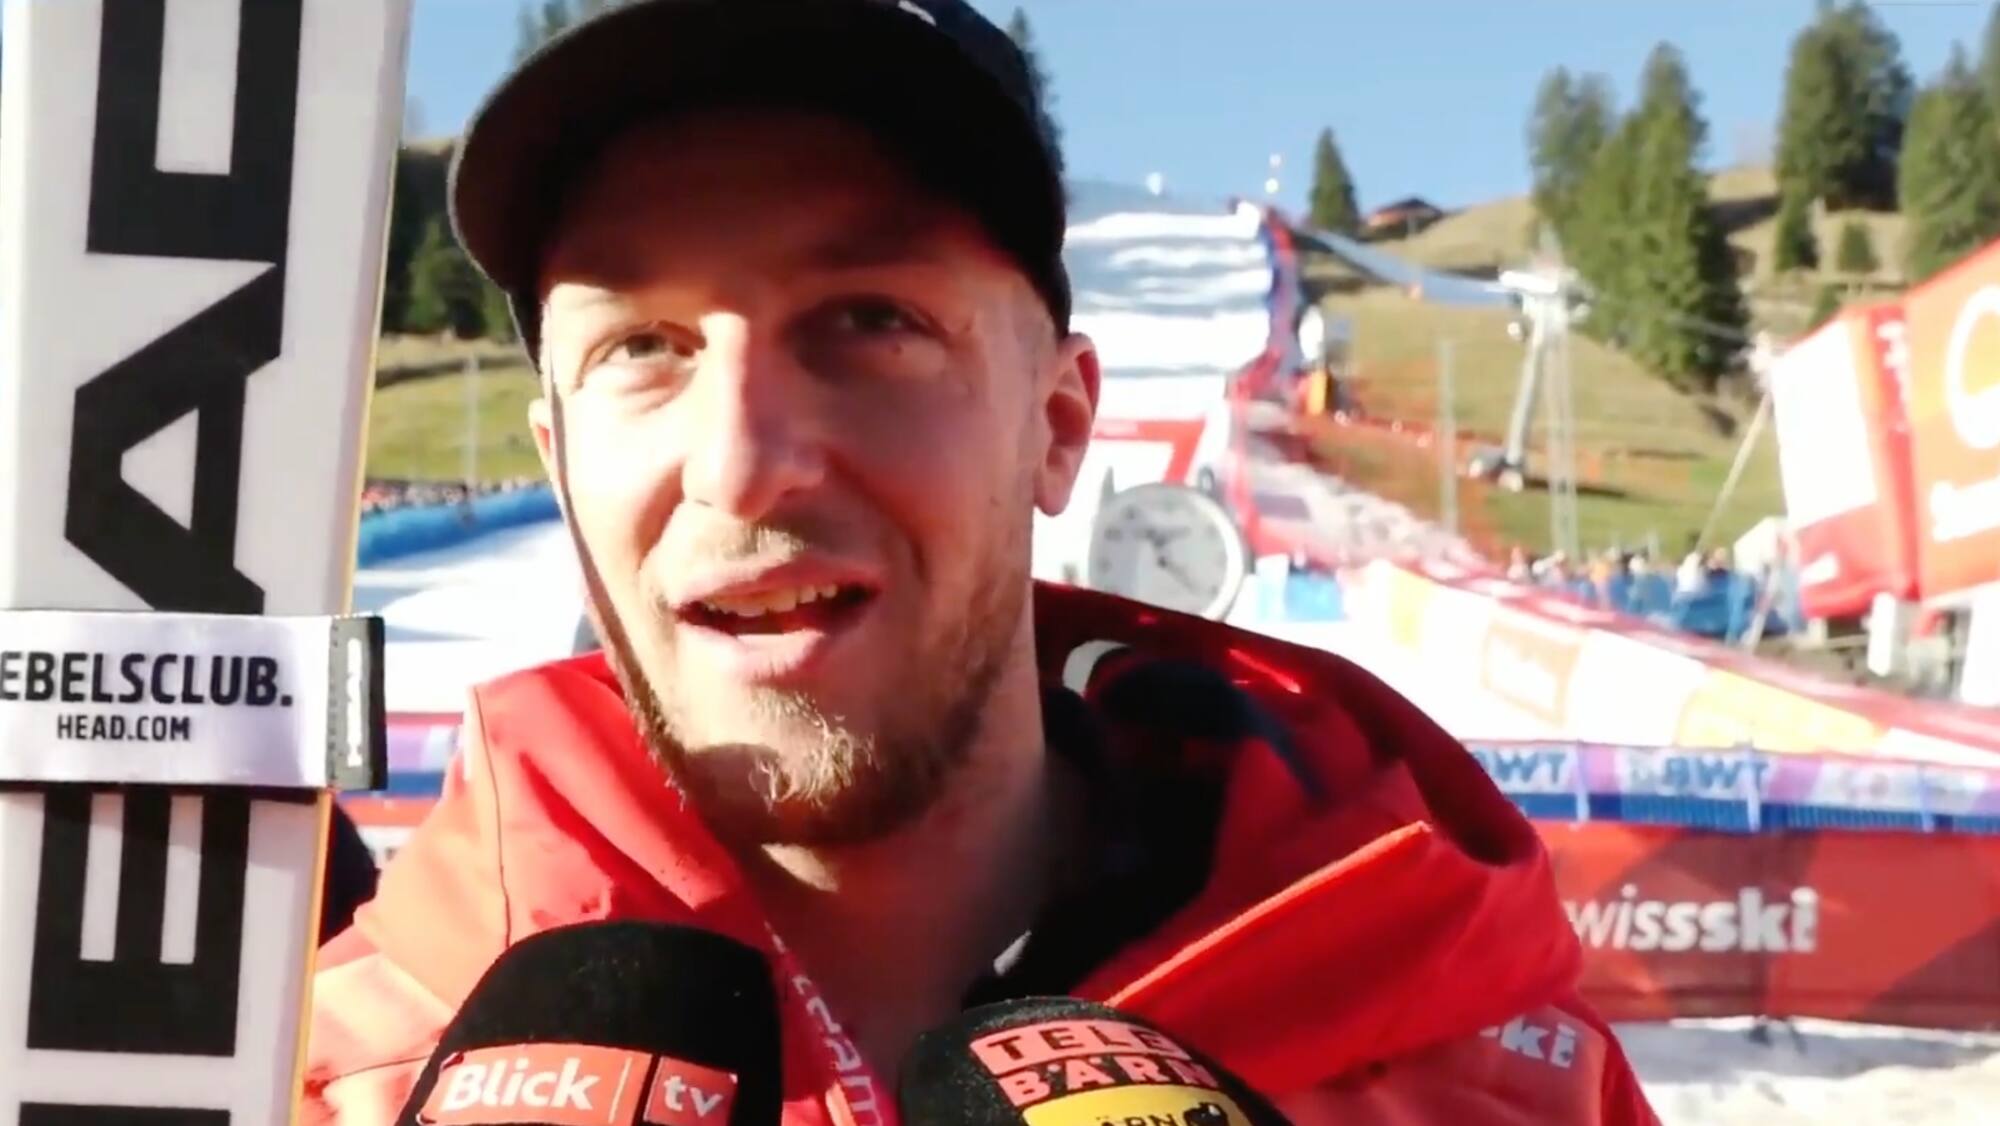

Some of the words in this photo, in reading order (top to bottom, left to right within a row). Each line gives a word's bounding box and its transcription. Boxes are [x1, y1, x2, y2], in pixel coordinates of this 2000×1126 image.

[57, 714, 192, 742] HEAD.COM
[1661, 755, 1769, 790] BWT
[986, 1024, 1181, 1062] TELE
[439, 1057, 601, 1112] Blick
[663, 1075, 722, 1117] tv
